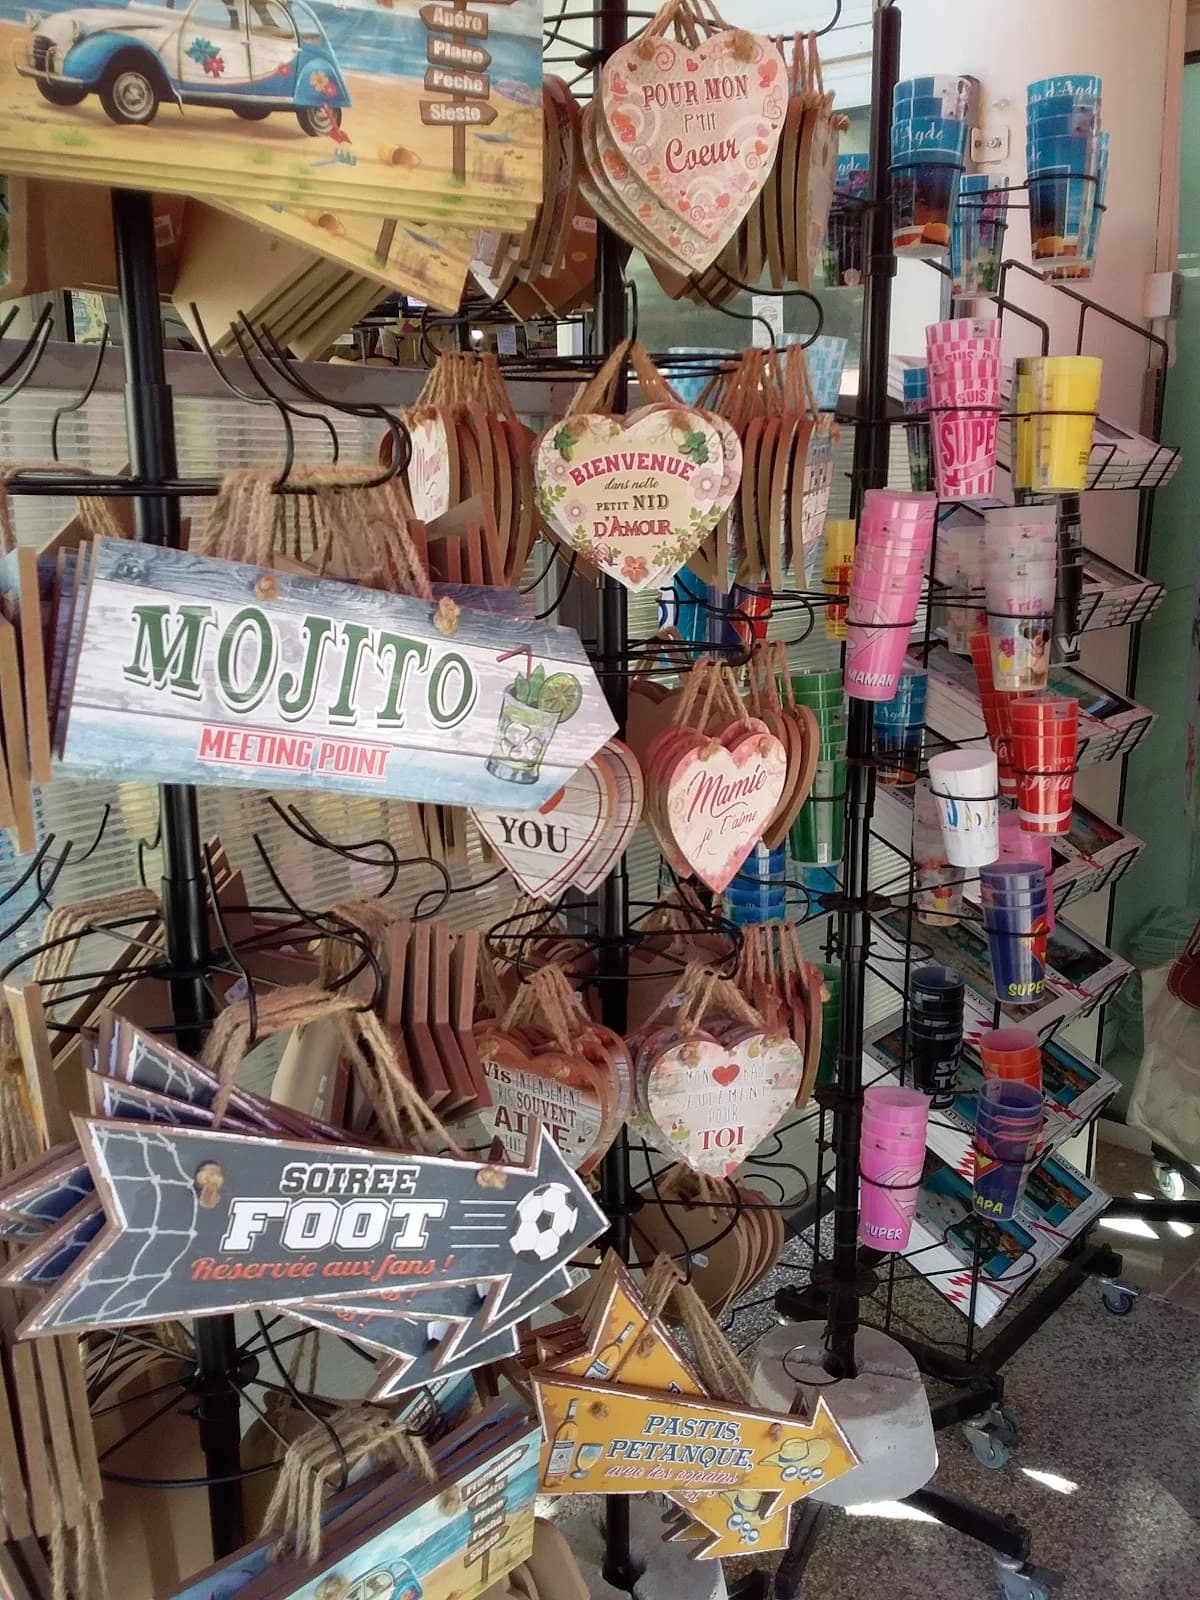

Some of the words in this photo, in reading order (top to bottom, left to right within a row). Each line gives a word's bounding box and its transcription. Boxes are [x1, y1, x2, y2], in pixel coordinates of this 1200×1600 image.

[433, 7, 482, 31] Apéro
[433, 40, 484, 64] Plage
[641, 80, 699, 111] POUR
[704, 74, 748, 104] MON
[430, 103, 481, 122] Sieste
[665, 137, 740, 175] Coeur
[568, 452, 697, 488] BIENVENUE
[603, 477, 631, 491] dans
[596, 502, 630, 512] PETIT
[632, 493, 671, 512] NID
[592, 515, 675, 538] D'AMOUR
[123, 604, 478, 730] MOJITO
[198, 727, 314, 769] MEETING
[314, 742, 392, 779] POINT
[686, 763, 768, 823] Mamie
[496, 815, 571, 854] YOU
[516, 1090, 578, 1128] SOUVENT
[697, 1125, 745, 1151] TOI
[280, 1163, 421, 1196] SOIREE
[974, 1193, 1004, 1215] APA
[219, 1198, 449, 1254] FOOT
[190, 1255, 318, 1282] Réservée
[321, 1258, 376, 1278] aux
[368, 1253, 437, 1283] fans
[643, 1415, 742, 1446] PASTIS,
[605, 1439, 754, 1473] PETANQUE,
